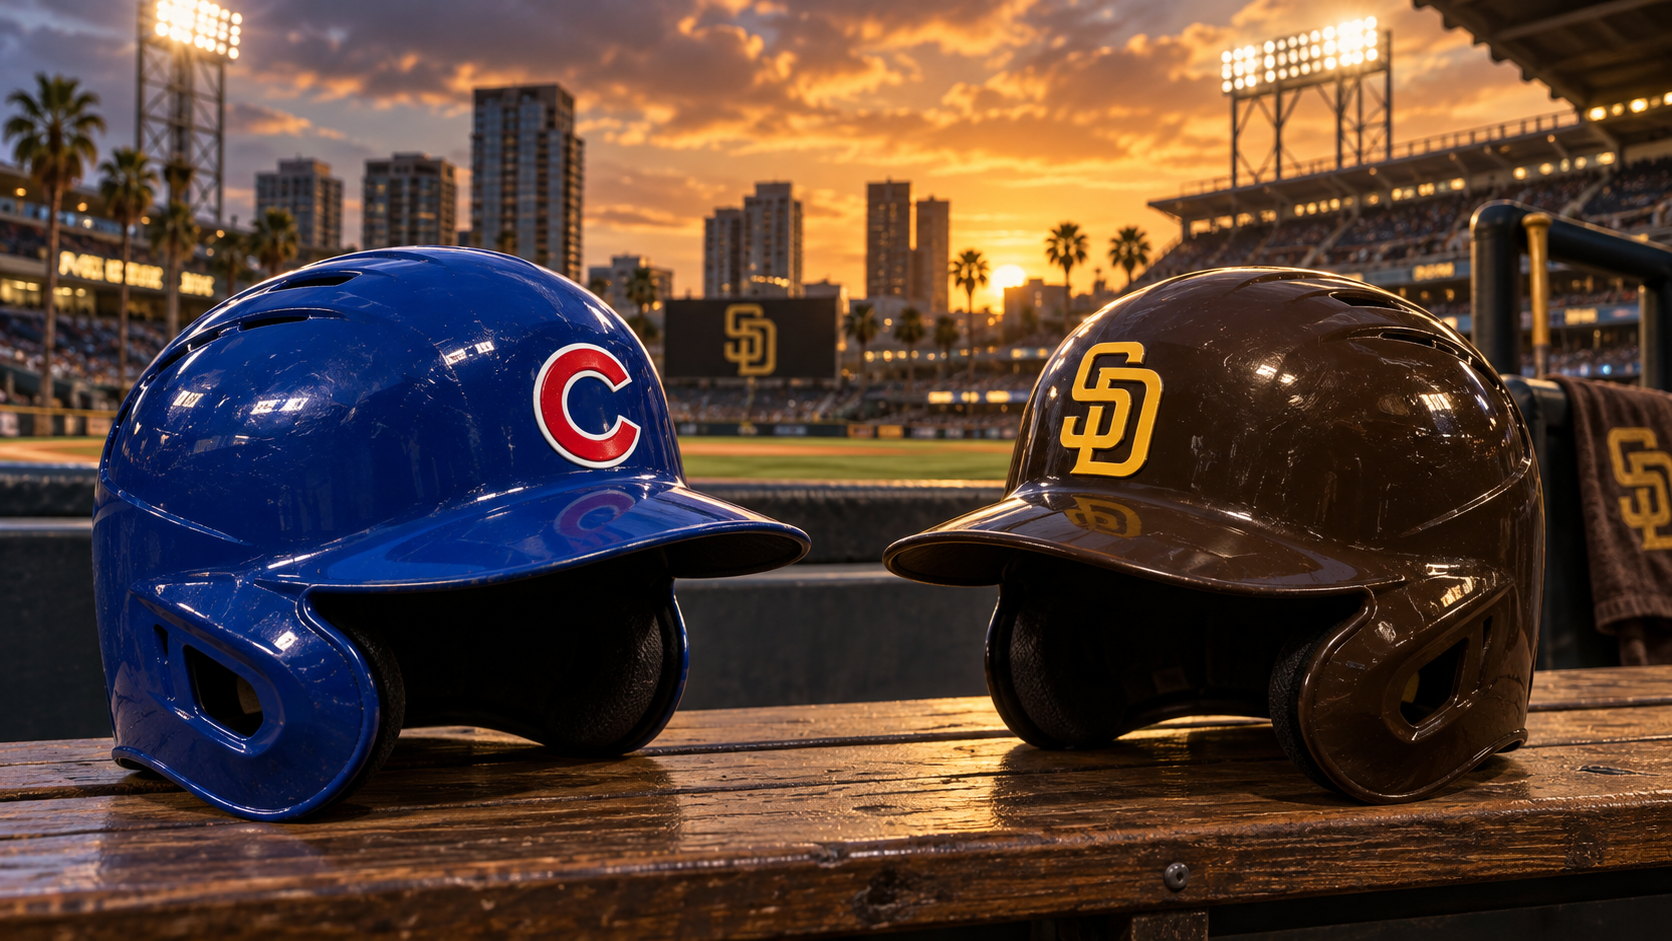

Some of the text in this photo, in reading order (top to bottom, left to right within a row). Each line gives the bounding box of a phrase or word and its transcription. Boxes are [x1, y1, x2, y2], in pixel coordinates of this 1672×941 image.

[723, 303, 777, 377] SD
[533, 342, 641, 469] C
[1060, 341, 1164, 477] SD
